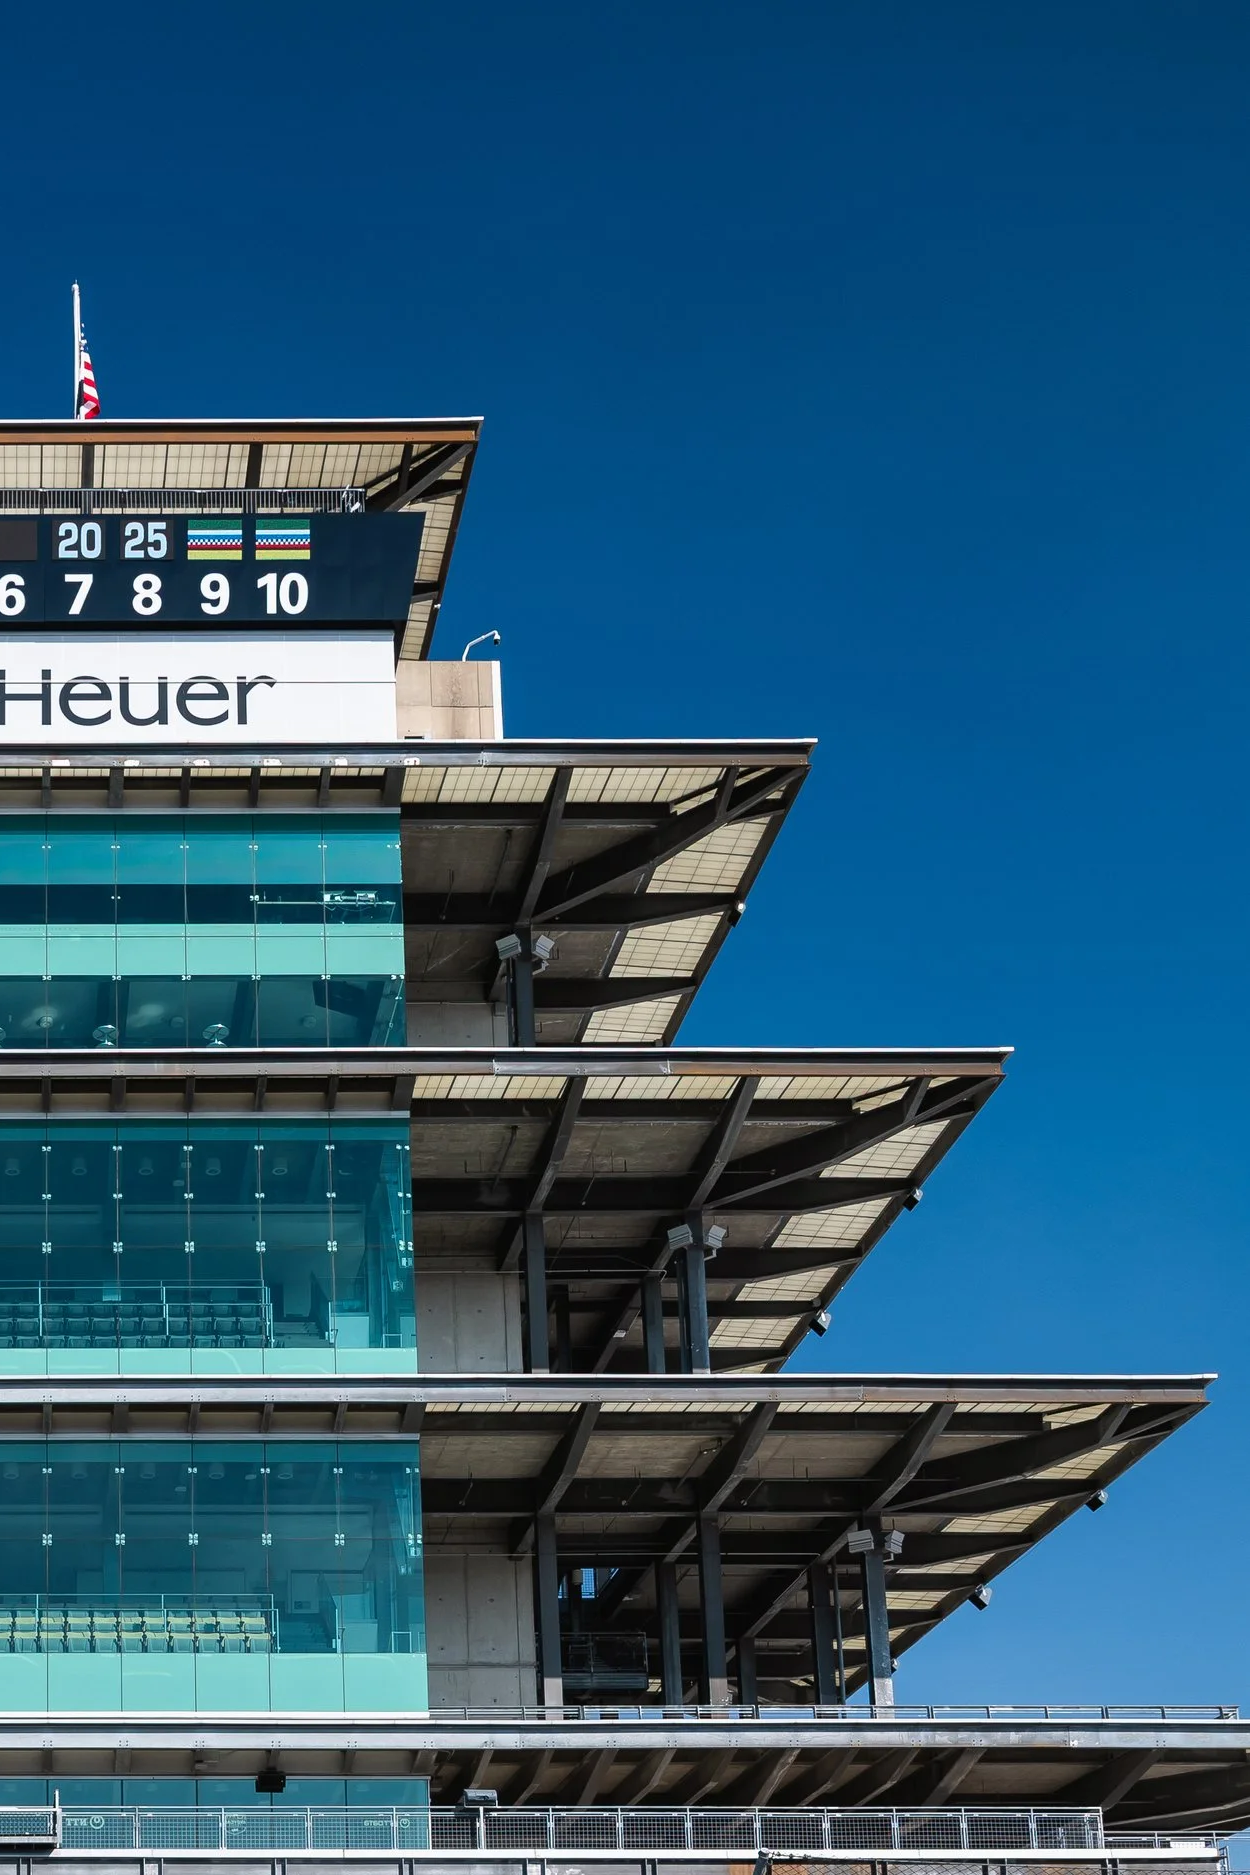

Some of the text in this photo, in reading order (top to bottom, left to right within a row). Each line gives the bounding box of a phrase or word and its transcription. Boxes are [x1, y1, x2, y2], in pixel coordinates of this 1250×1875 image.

[58, 521, 102, 559] 20
[124, 521, 168, 559] 25
[64, 573, 94, 615] 7
[132, 573, 163, 616] 8
[200, 573, 230, 616] 9
[257, 572, 309, 615] 10
